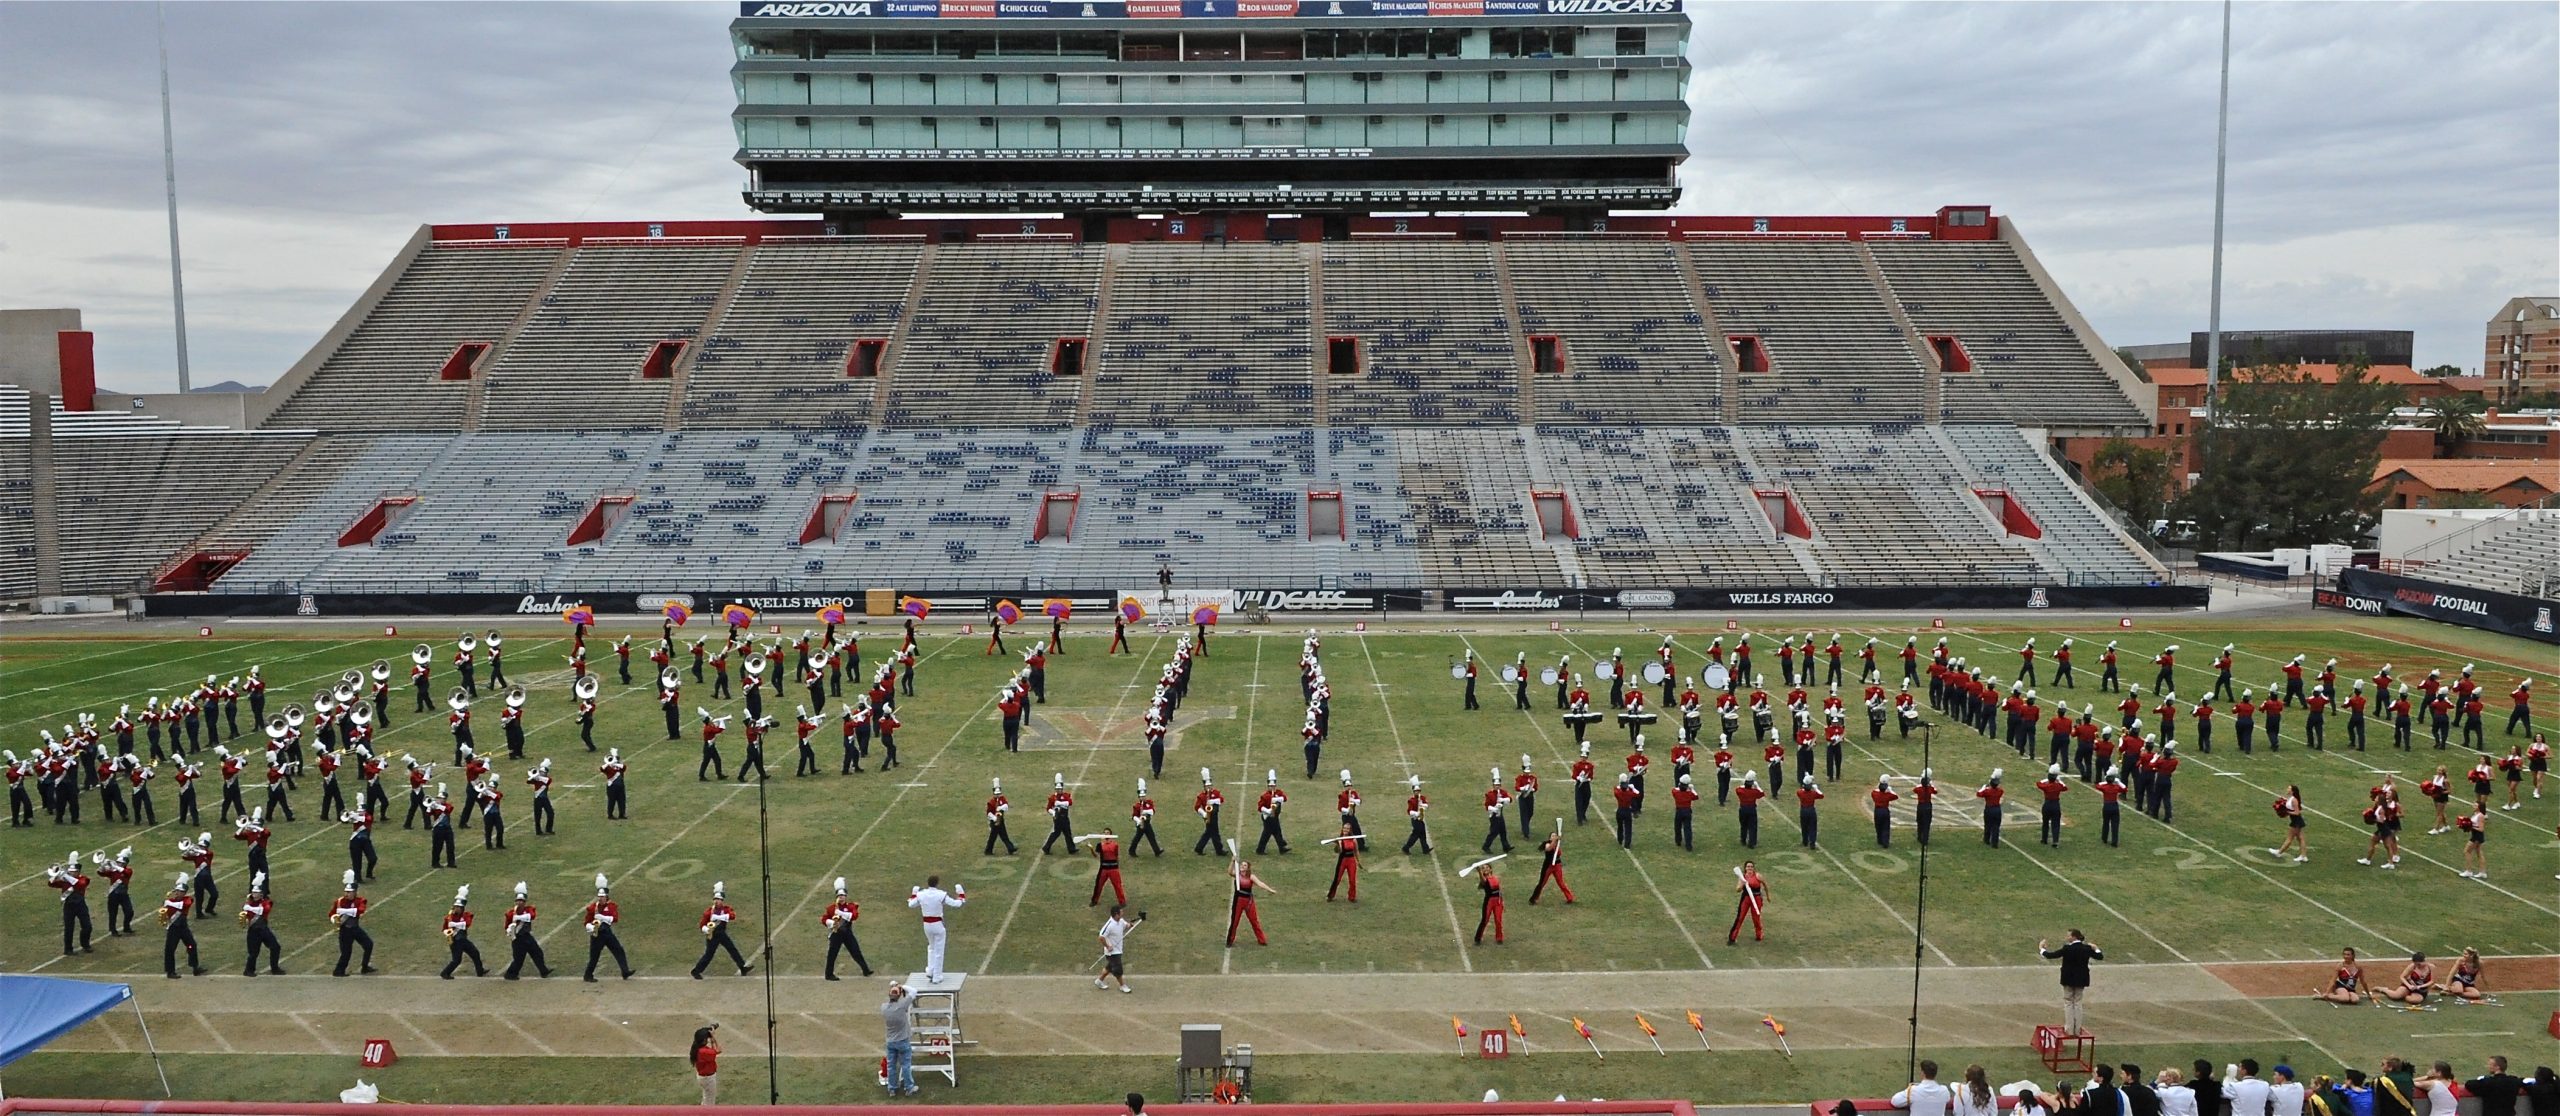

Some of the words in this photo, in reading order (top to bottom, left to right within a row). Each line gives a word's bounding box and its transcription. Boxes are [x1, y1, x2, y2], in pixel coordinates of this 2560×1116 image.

[754, 3, 872, 16] ARIZONA
[1491, 2, 1517, 10] ANTOINE
[1517, 2, 1539, 10] CASON
[1547, 0, 1675, 13] WILDCATS
[825, 227, 836, 236] 19
[1022, 225, 1035, 235] 20
[1171, 224, 1183, 234] 21
[1395, 224, 1408, 233] 22
[1593, 223, 1606, 232] 23
[1754, 223, 1767, 232] 24
[1892, 223, 1905, 233] 25
[497, 230, 508, 240] 17
[650, 228, 662, 238] 18
[133, 399, 144, 408] 16
[748, 597, 800, 608] WELLS
[803, 597, 854, 608] FARGO
[1729, 593, 1781, 604] WELLS
[1784, 593, 1834, 604] FARGO
[2346, 596, 2382, 613] DOWN
[2433, 595, 2488, 615] FOOTBALL
[1485, 1034, 1503, 1054] 40
[365, 1043, 384, 1064] 40
